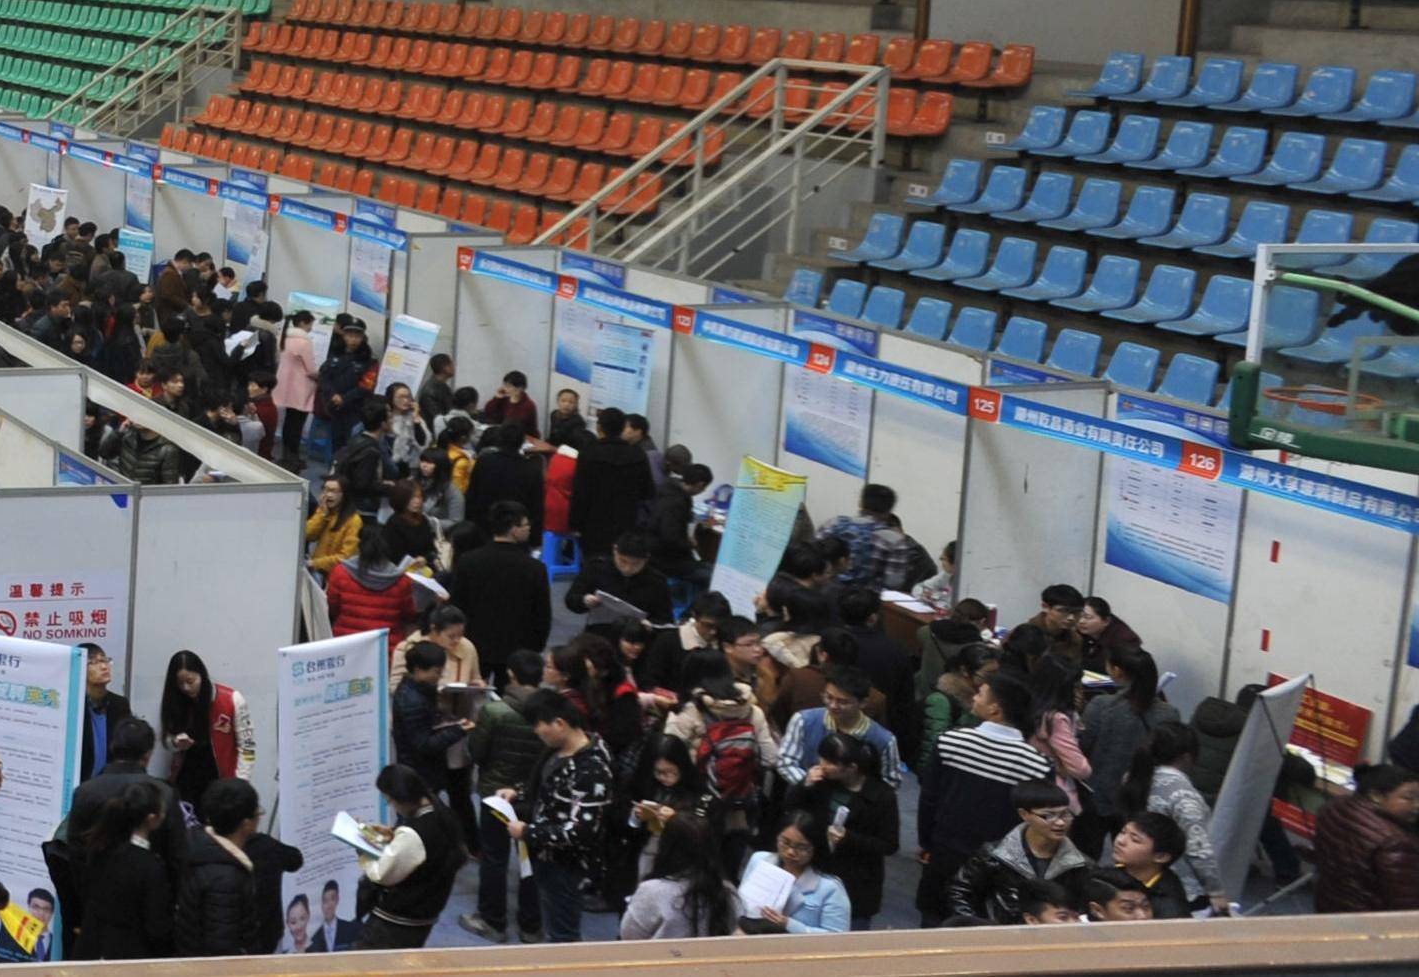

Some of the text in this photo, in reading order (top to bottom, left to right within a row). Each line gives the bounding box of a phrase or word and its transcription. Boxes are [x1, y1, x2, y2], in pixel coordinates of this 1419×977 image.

[973, 398, 995, 414] 125
[1189, 452, 1216, 471] 126
[1238, 464, 1419, 525] 湖州大享玻璃制品有限公
[9, 582, 85, 598] 温馨提示
[24, 609, 107, 627] 禁止吸烟
[23, 628, 107, 640] NO SOMKING
